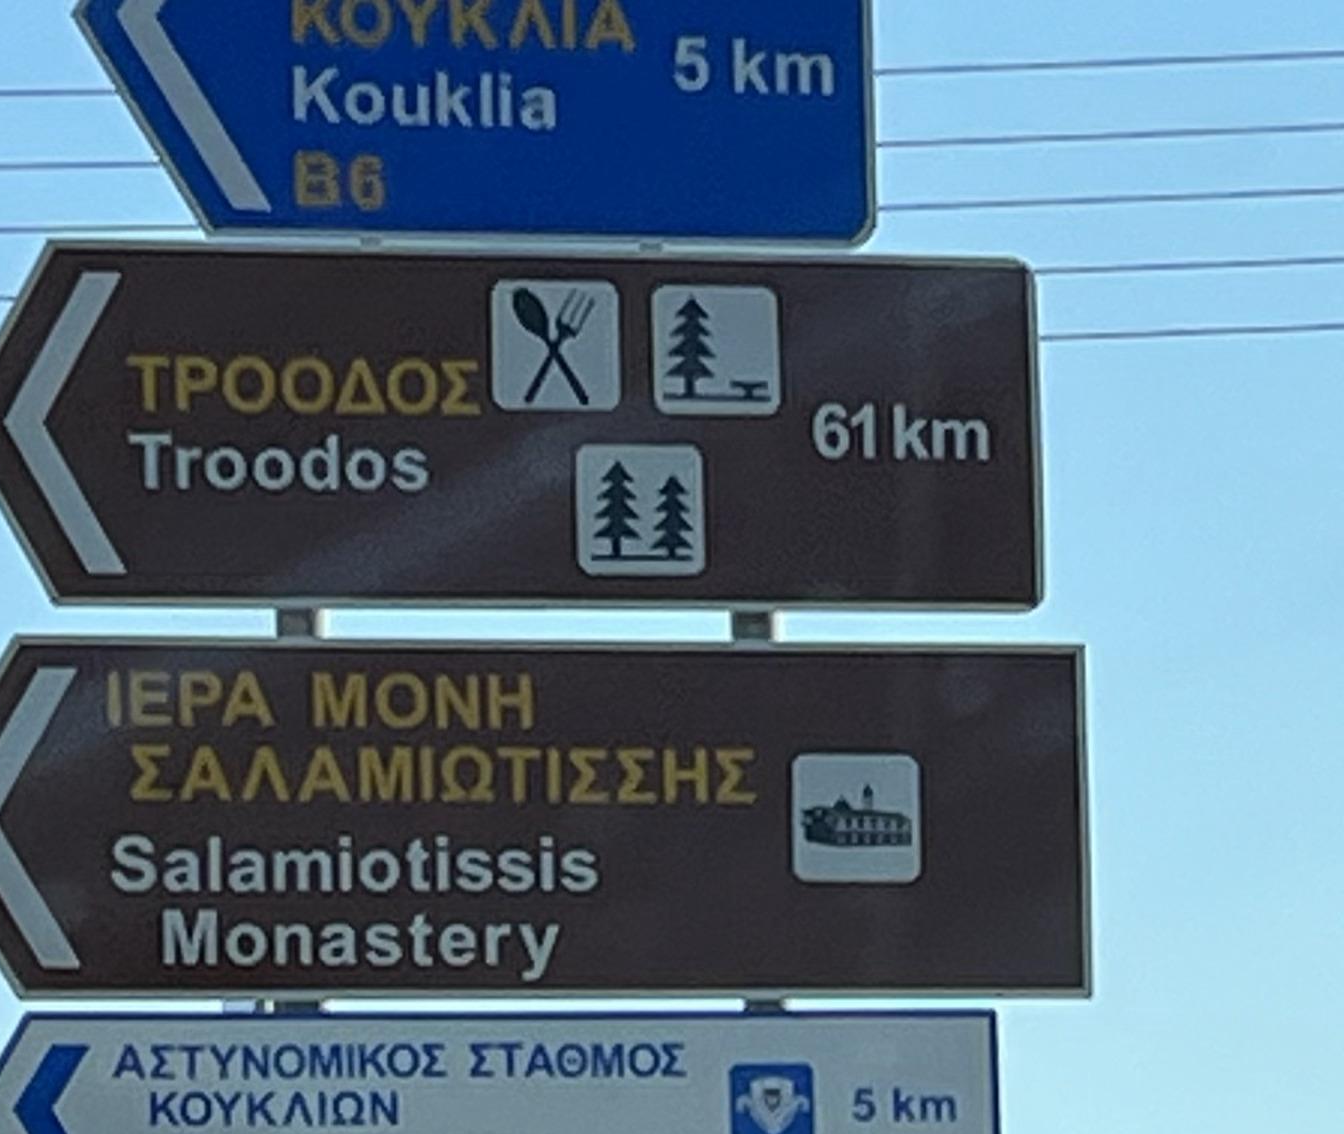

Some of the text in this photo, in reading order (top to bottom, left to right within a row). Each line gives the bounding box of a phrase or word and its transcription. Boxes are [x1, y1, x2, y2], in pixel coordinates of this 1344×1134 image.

[290, 0, 637, 52] ΚΟΥΚΛΙΑ
[673, 36, 835, 97] 5 km
[291, 64, 558, 131] Kouklia
[292, 148, 388, 211] B6
[126, 353, 482, 416] ΤΡΟΟΔΟΣ
[128, 433, 430, 493] Troodos
[810, 402, 992, 463] 61 km
[106, 669, 537, 730] ΙΕΡΑ ΜΟΝΗ
[128, 744, 758, 805] ΣΑΛΑΜΙΩΤΙΣΣΗΣ
[110, 835, 600, 893] Salamiotissis
[161, 908, 560, 982] Monastery
[112, 1041, 688, 1080] ΑΣΤΥΝΟΜΙΚΟΣ ΣΤΑΘΜΟΣ
[149, 1090, 401, 1127] ΚΟΥΚΛΙΩΝ
[852, 1087, 957, 1123] 5 km
